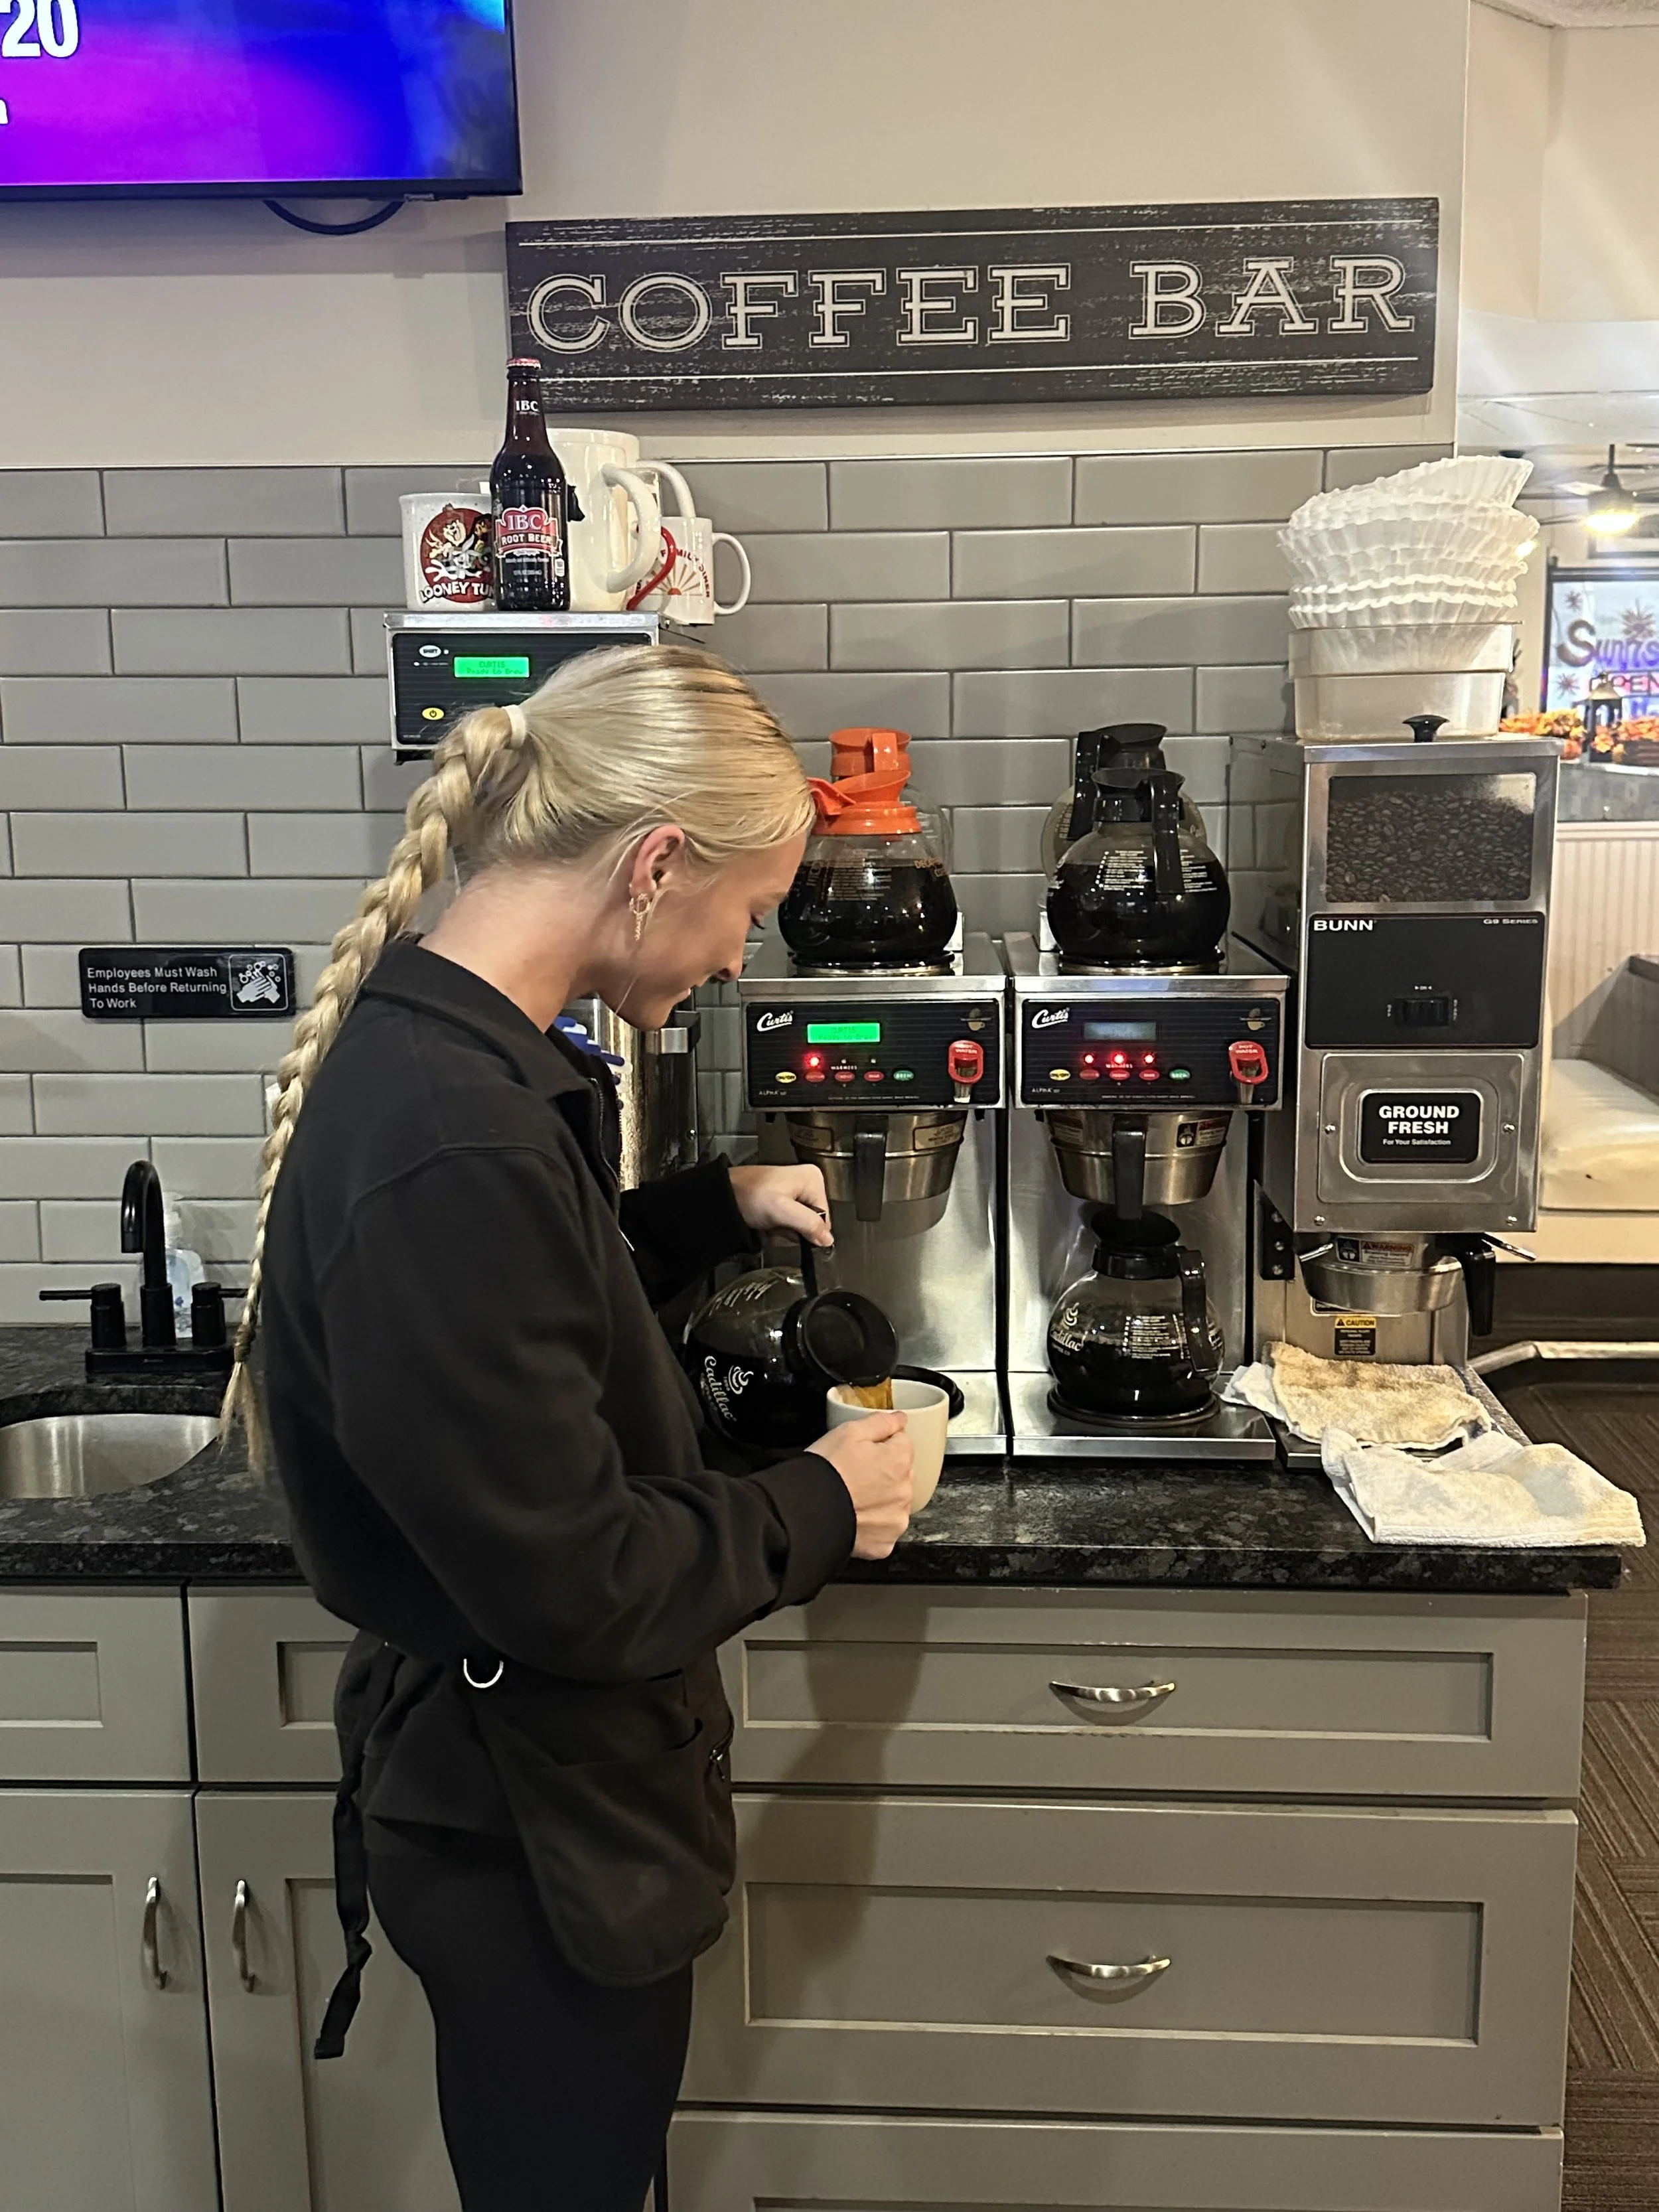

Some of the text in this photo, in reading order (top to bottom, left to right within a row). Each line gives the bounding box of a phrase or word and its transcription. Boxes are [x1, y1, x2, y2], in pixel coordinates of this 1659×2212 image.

[527, 255, 1415, 354] COFFEE BAR
[516, 400, 539, 411] IBC
[508, 514, 542, 530] IBC
[501, 533, 552, 546] ROOT BEER
[419, 581, 470, 603] LOONEY
[1313, 919, 1374, 931] BUNN
[88, 967, 218, 979] Employees Must Wash
[88, 982, 227, 994] Hands Before Returning
[90, 997, 137, 1009] To Work
[757, 1011, 794, 1032] Curtis
[1031, 1007, 1070, 1029] Curtis
[1379, 1105, 1460, 1119] GROUND
[1388, 1121, 1449, 1134] FRESH
[703, 1355, 733, 1420] Cadillac
